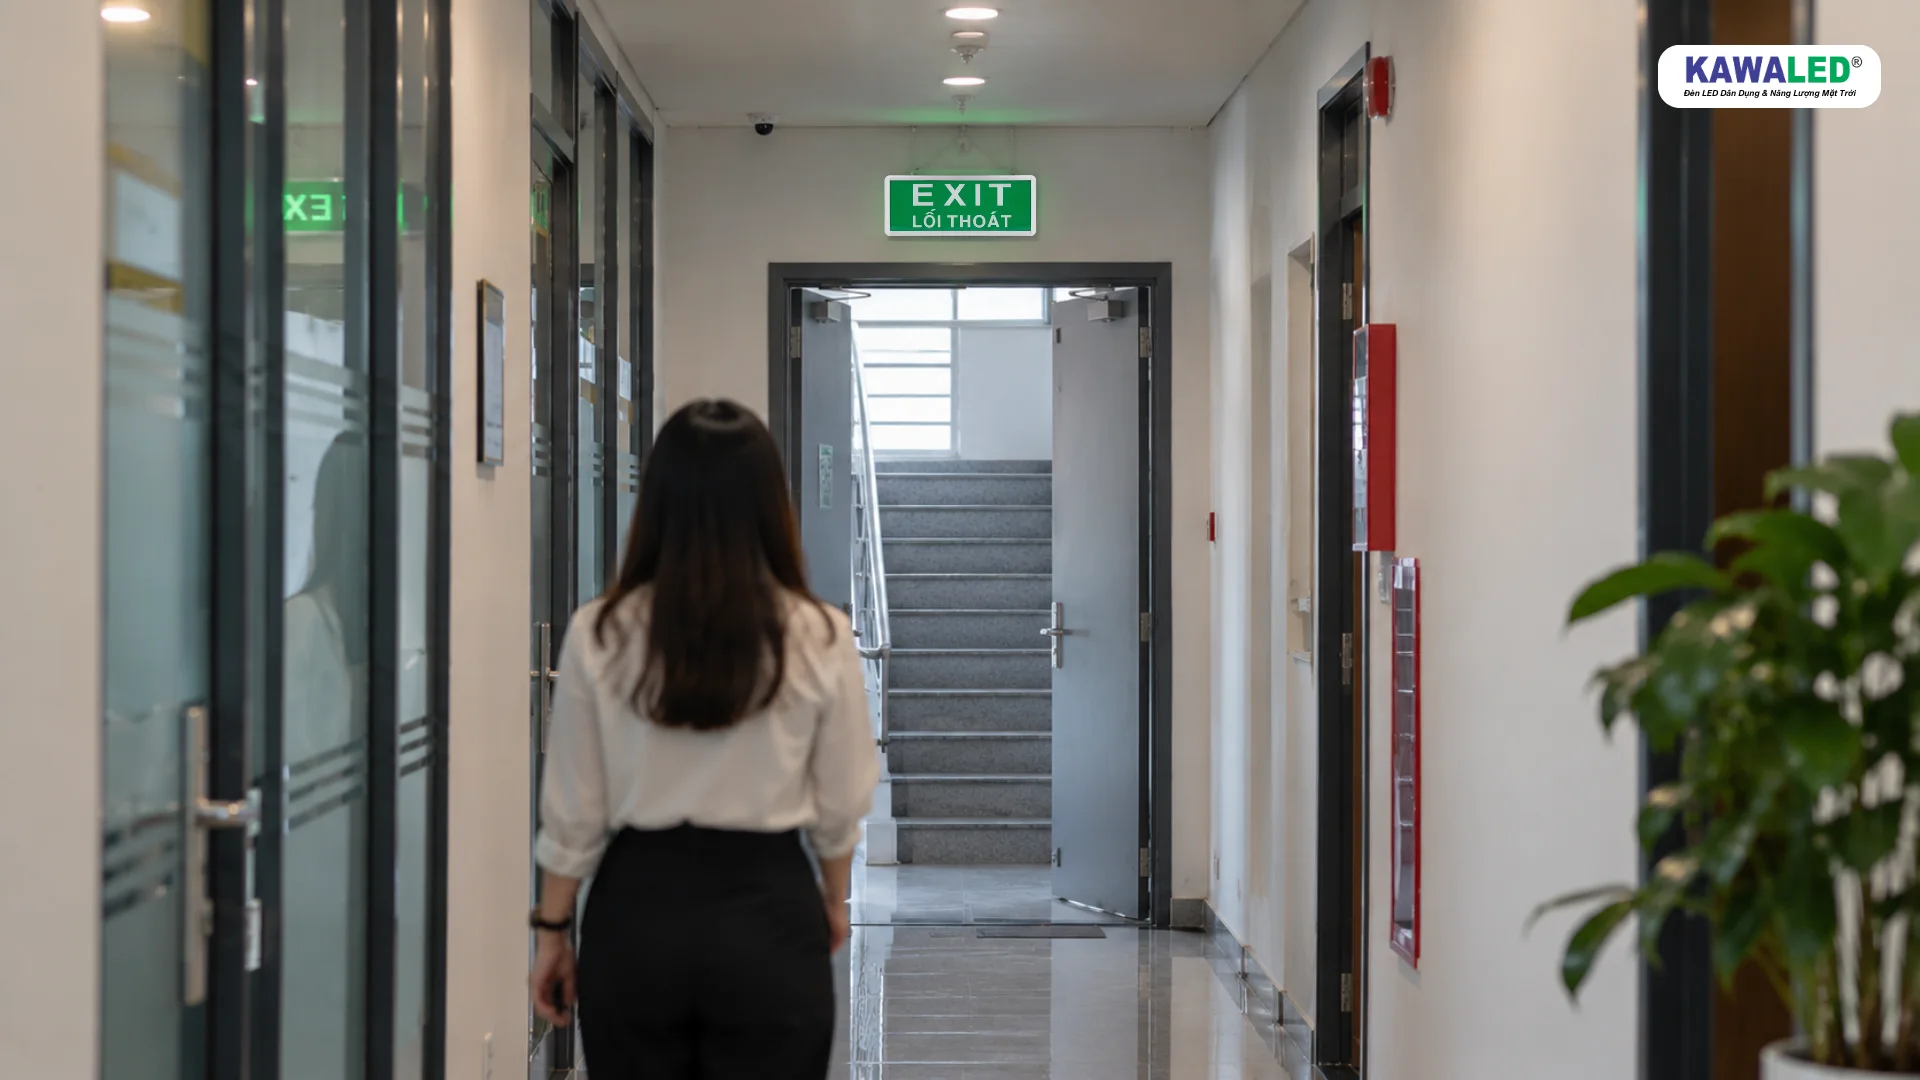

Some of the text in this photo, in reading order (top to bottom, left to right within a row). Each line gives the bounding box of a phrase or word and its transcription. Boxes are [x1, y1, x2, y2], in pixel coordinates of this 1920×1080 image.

[912, 183, 1012, 207] EXIT
[912, 209, 1012, 228] LỐI THOÁT
